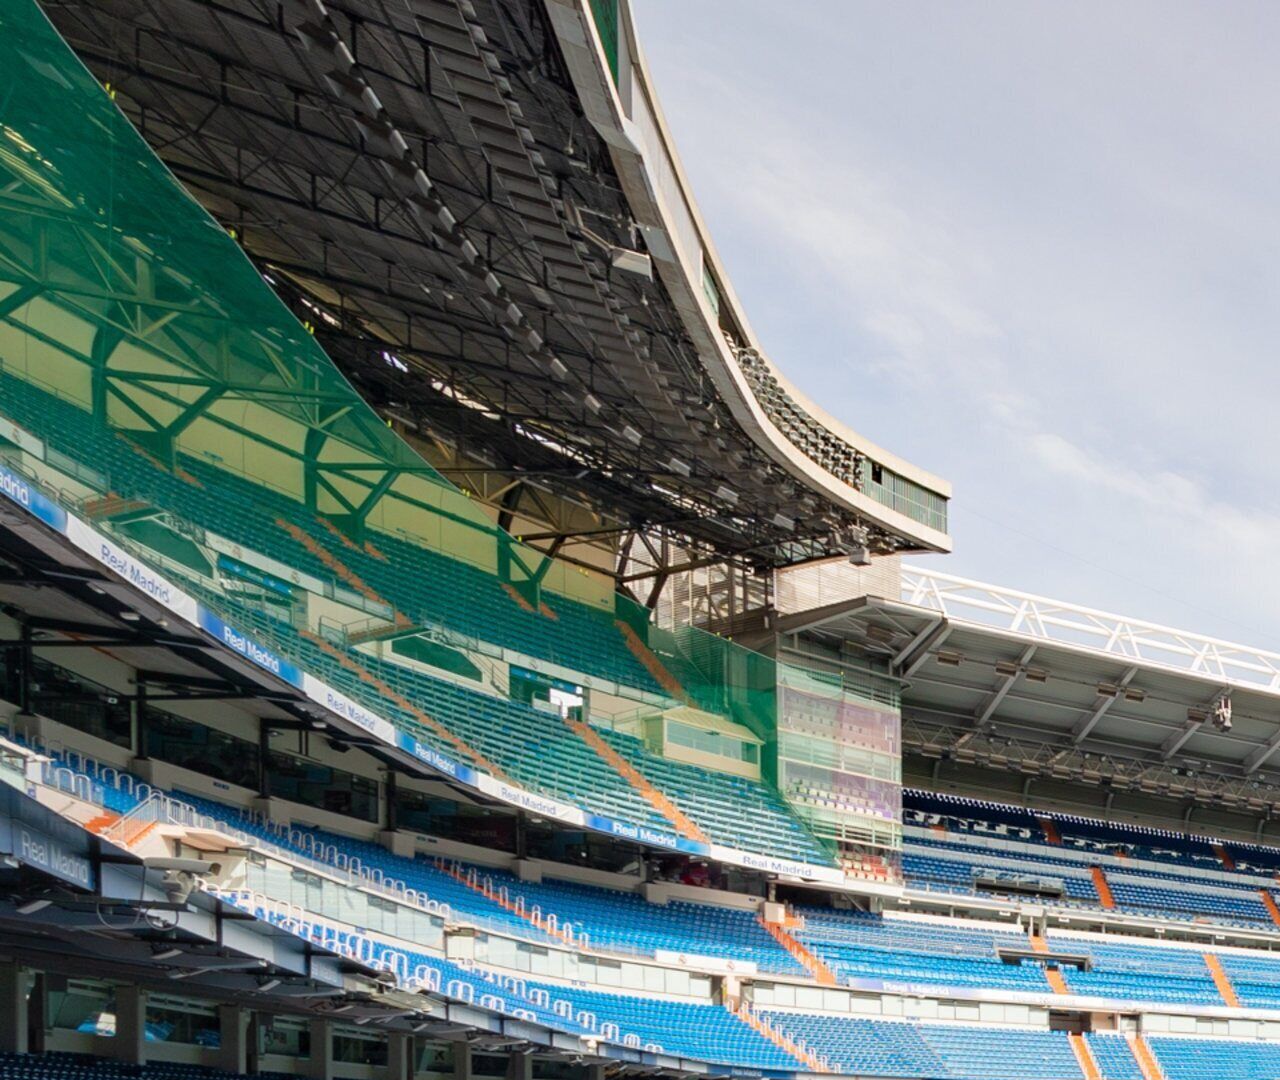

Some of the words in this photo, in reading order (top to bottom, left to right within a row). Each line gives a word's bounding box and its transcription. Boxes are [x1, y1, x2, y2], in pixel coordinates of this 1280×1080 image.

[0, 472, 29, 505] adrid
[101, 543, 127, 575] Real
[129, 565, 170, 603] Madrid
[223, 626, 246, 653] Real
[246, 640, 280, 673] Madrid
[327, 692, 347, 713] Real
[348, 704, 376, 732] Madrid
[415, 742, 432, 762] Real
[432, 753, 456, 775] Madrid
[501, 787, 520, 803] Real
[522, 794, 557, 816] Madrid
[612, 822, 638, 838] Real
[639, 828, 677, 847] Madrid
[21, 831, 48, 866] Real
[50, 846, 88, 883] Madrid
[743, 855, 768, 869] Real
[771, 861, 813, 878] Madrid
[882, 981, 908, 992] Real
[909, 984, 949, 996] Madrid
